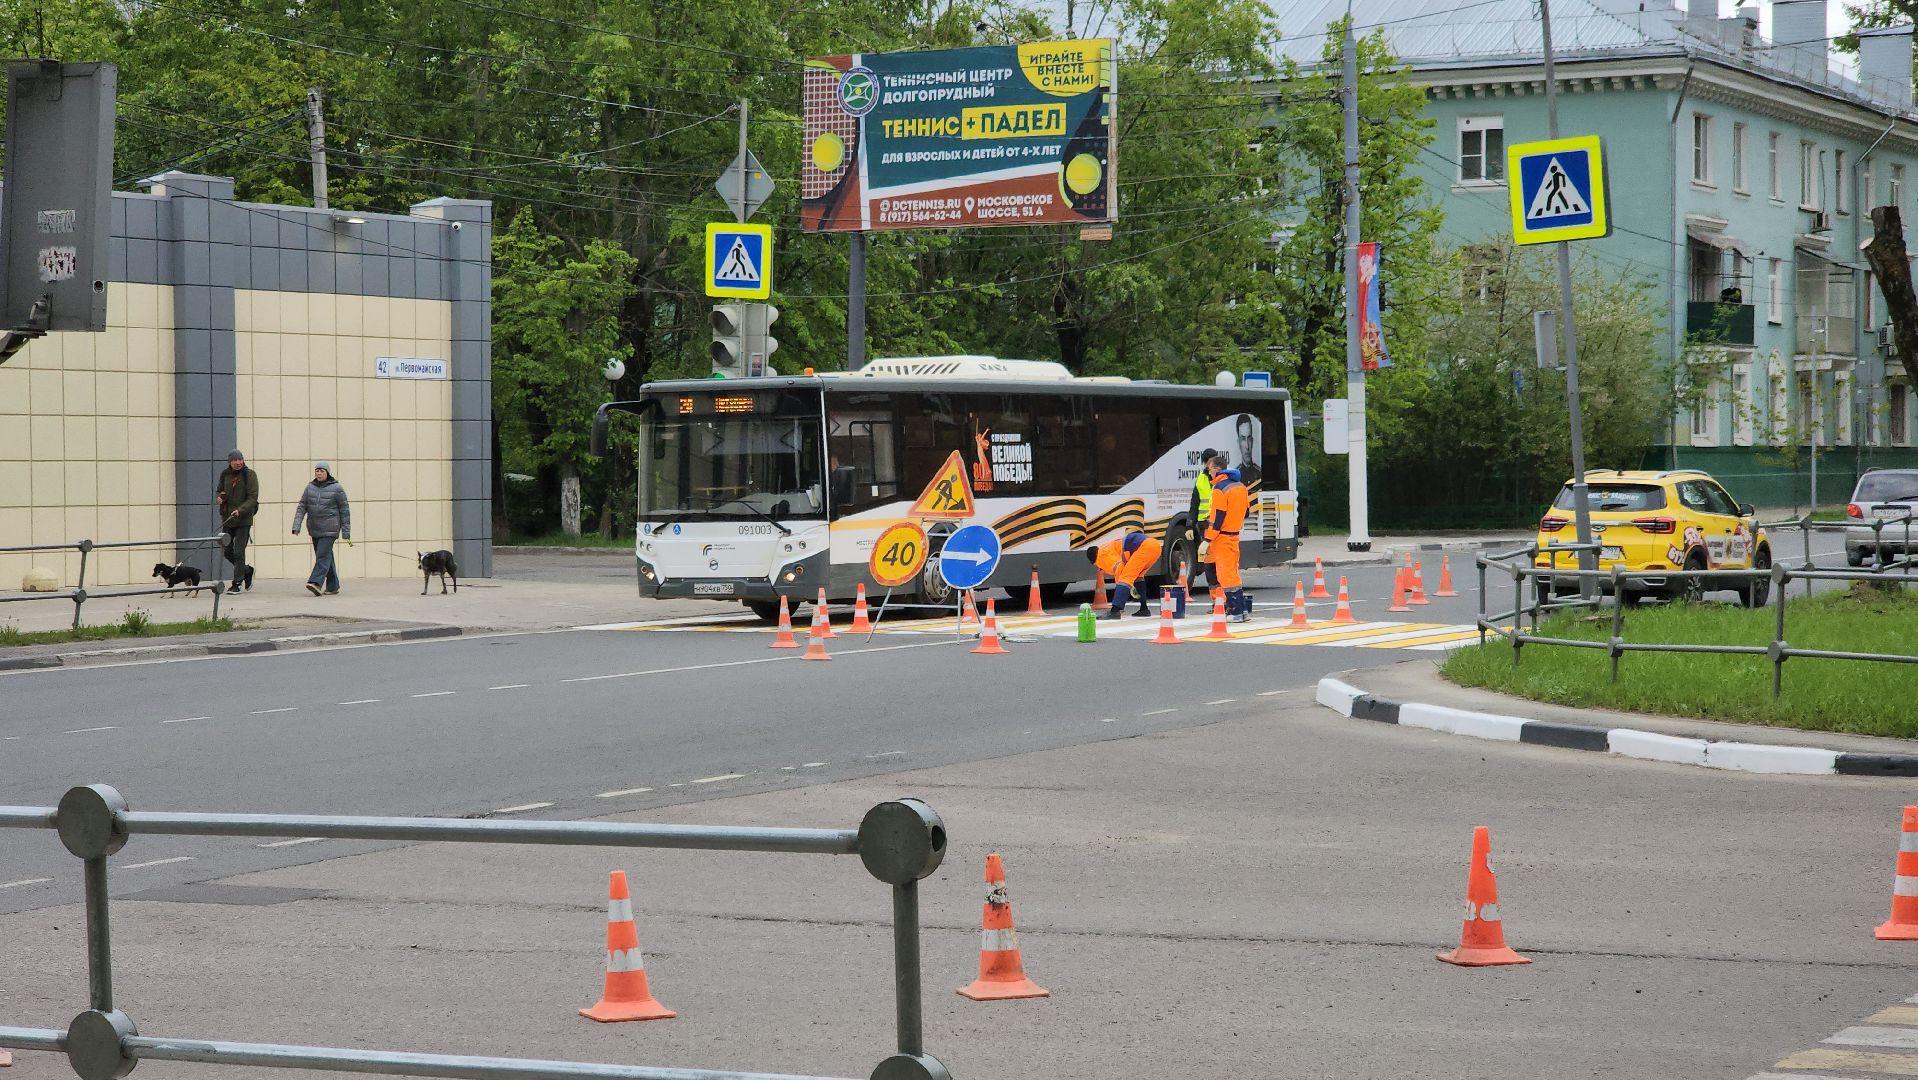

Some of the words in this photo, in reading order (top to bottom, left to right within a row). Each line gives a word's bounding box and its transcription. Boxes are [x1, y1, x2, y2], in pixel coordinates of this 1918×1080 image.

[1030, 50, 1083, 64] ИГРАЙТЕ
[1037, 63, 1084, 75] ВМЕСТЕ
[883, 69, 966, 87] ТЕННИСНЫЙ
[969, 68, 1013, 83] ЦЕНТР
[1042, 77, 1050, 86] С
[1054, 75, 1094, 86] НАМИ!
[882, 83, 994, 105] ДОЛГОПРУДНЫЙ
[882, 116, 960, 139] ТЕННИС
[882, 152, 903, 164] ДЛЯ
[905, 149, 961, 162] ВЗРОСЛЫХ
[963, 149, 970, 159] И
[972, 146, 1005, 161] ДЕТЕЙ
[1007, 147, 1019, 157] ОТ
[1041, 145, 1061, 155] ЛЕТ
[892, 198, 961, 211] DCTENNIS.RU
[977, 194, 1053, 207] МОСКОВСКОЕ
[912, 210, 961, 221] 564-62-44
[978, 206, 1020, 218] ШОССЕ,
[378, 361, 387, 373] 42
[400, 362, 442, 375] Первомайская
[991, 443, 1032, 463] ВЕЛИКОЙ
[993, 463, 1032, 484] ПОБЕДЫ!
[738, 525, 772, 535] 091003
[882, 541, 915, 567] 40
